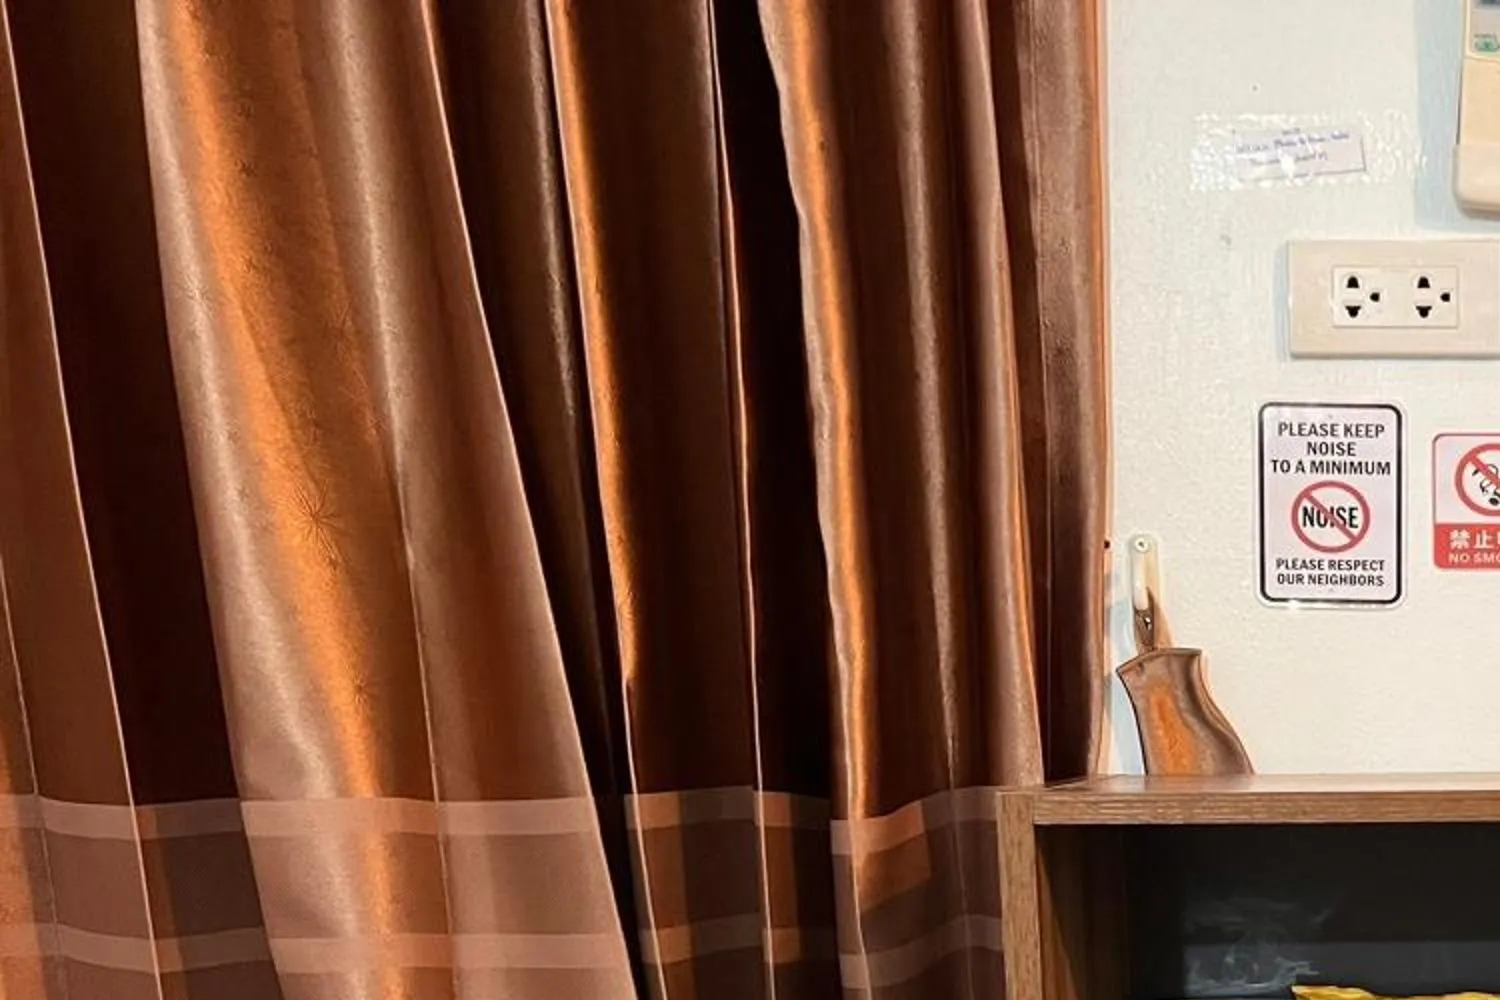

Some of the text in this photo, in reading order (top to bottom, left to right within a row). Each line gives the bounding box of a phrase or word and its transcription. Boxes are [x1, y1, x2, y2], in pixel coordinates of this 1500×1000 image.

[1278, 422, 1385, 438] PLEASE KEEP
[1306, 441, 1357, 456] NOISE
[1271, 459, 1391, 475] TO A MINIMUM
[1302, 505, 1359, 529] NOISE
[1276, 558, 1386, 572] PLEASE RESPECT
[1448, 552, 1471, 564] NO
[1277, 573, 1385, 587] OUR NEIGHBORS
